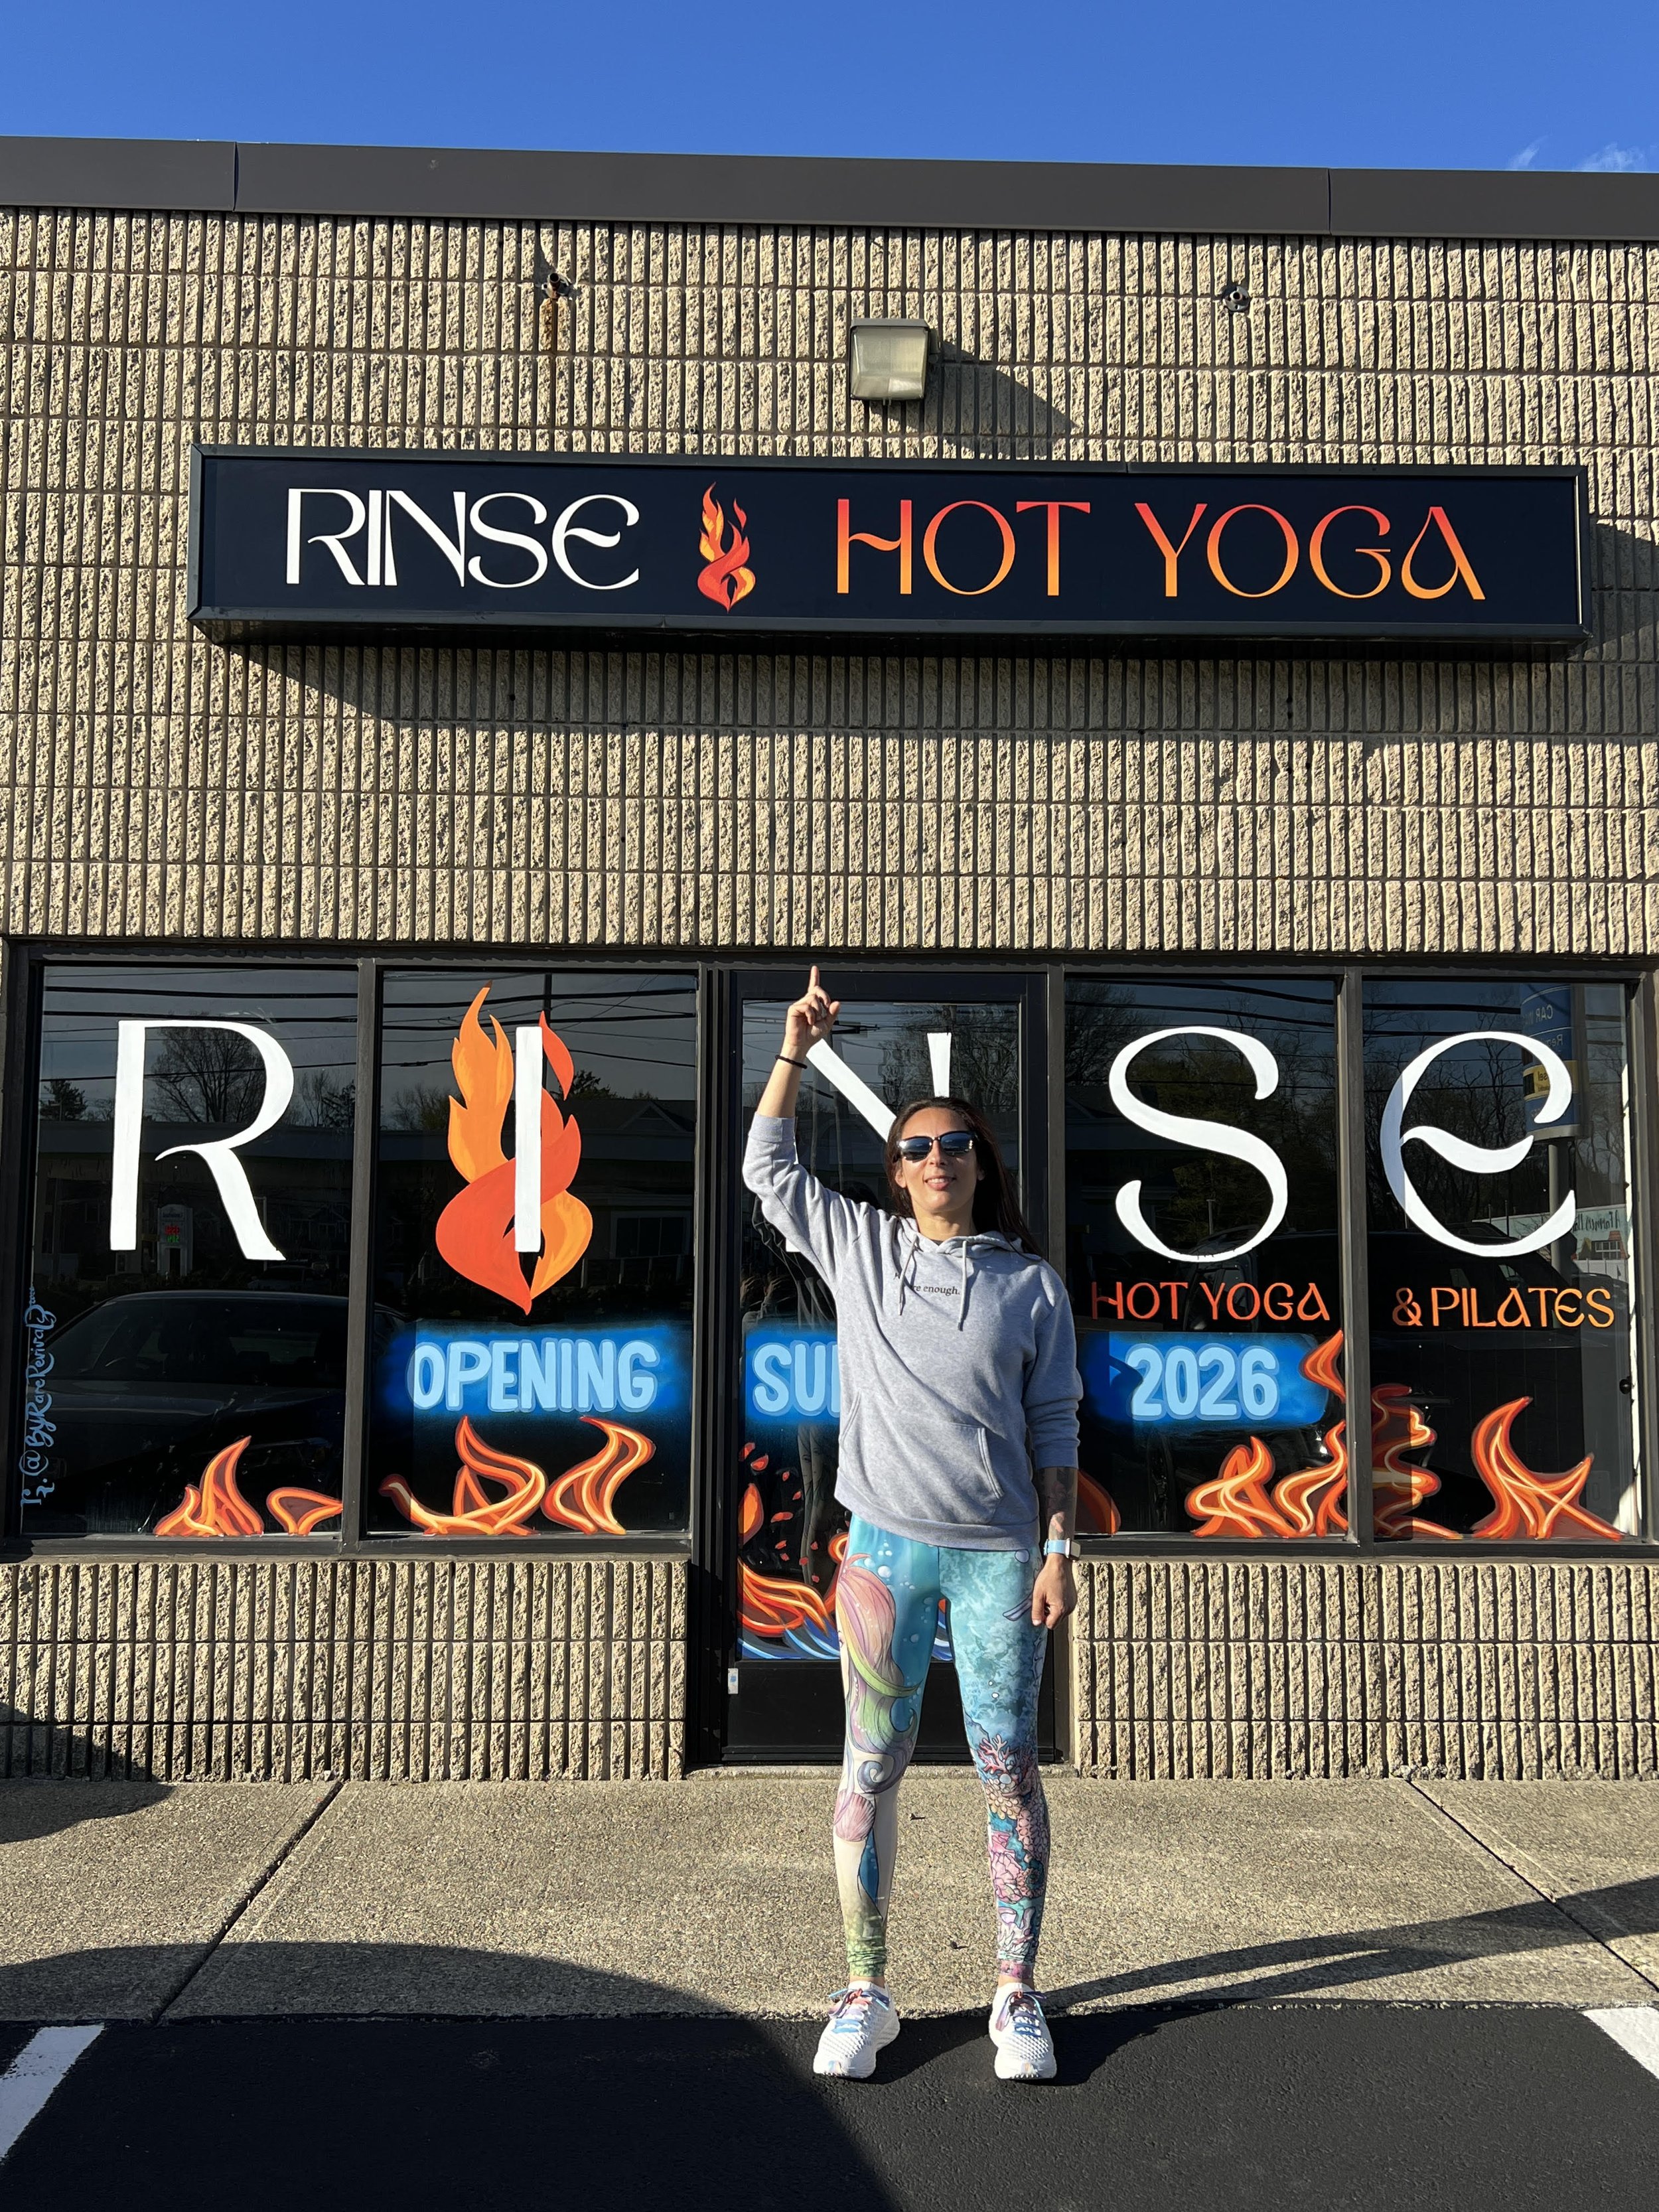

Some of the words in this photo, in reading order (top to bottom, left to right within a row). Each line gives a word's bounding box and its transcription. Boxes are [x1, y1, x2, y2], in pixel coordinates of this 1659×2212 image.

[287, 488, 640, 590] RINSE
[837, 498, 1091, 597] HOT
[1135, 502, 1486, 601] YOGA
[923, 1286, 961, 1296] enough.
[1092, 1282, 1188, 1319] HOT
[1199, 1282, 1330, 1321] YOGA
[1392, 1287, 1423, 1326] &
[1431, 1287, 1615, 1328] PILATES
[407, 1337, 661, 1414] OPENING
[1125, 1343, 1279, 1420] 2026
